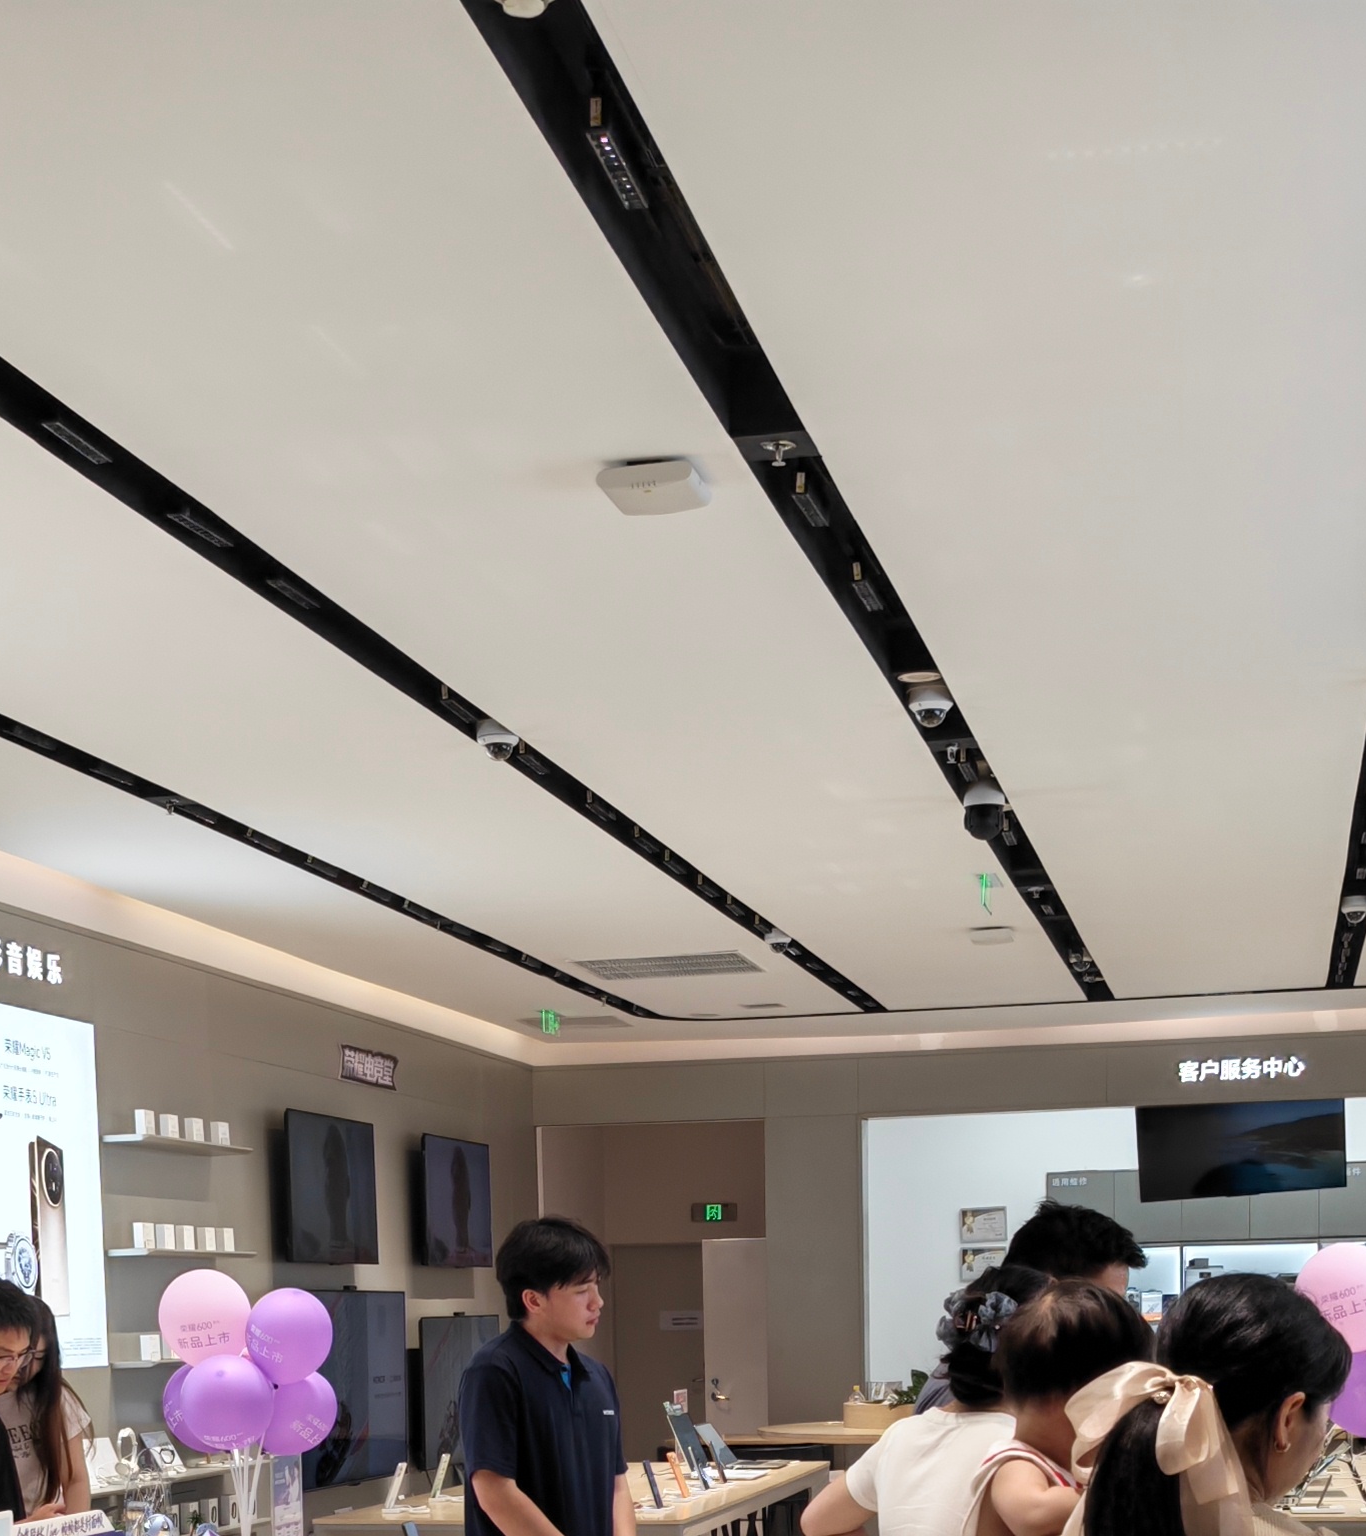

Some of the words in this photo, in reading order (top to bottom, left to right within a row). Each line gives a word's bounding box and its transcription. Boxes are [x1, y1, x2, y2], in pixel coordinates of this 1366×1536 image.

[1178, 1056, 1306, 1083] 客户服务中心
[177, 1331, 231, 1350] 新品上市
